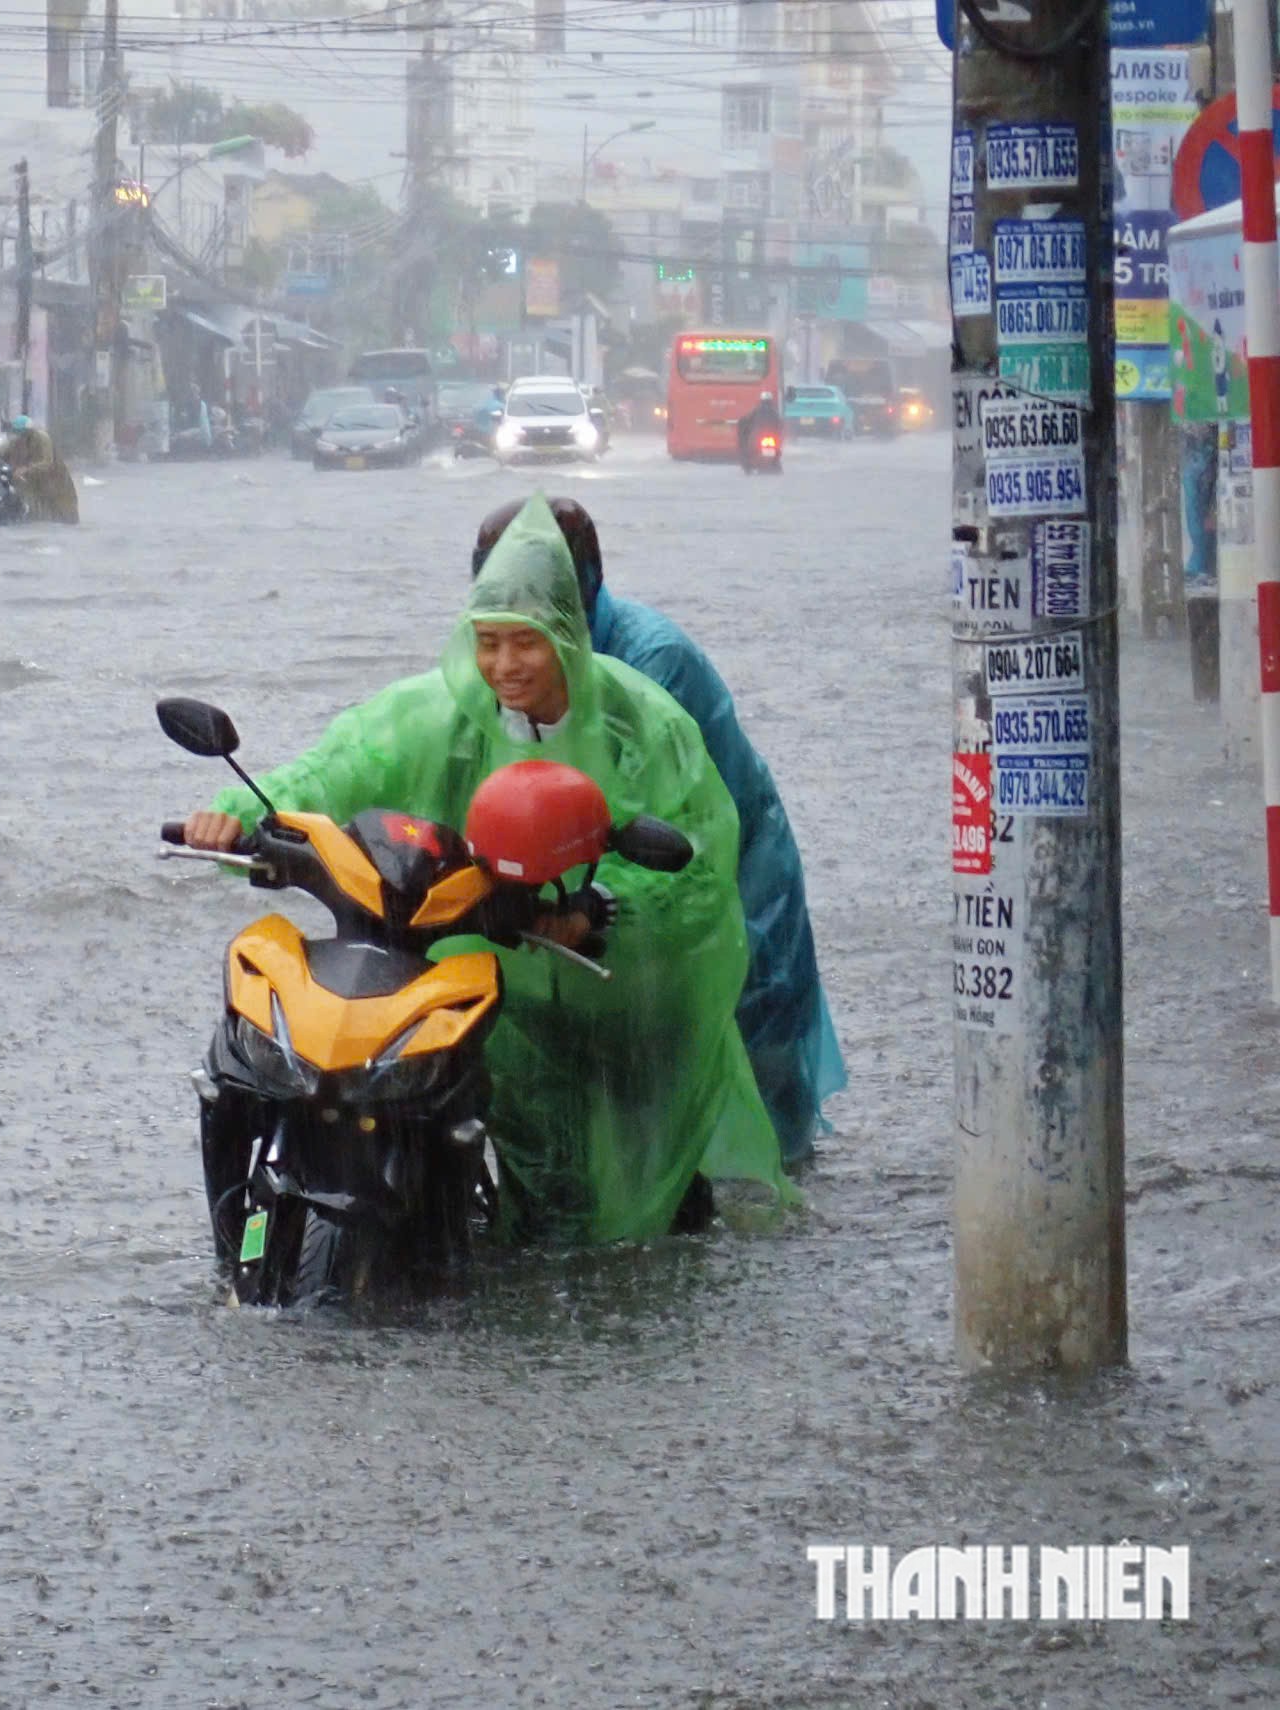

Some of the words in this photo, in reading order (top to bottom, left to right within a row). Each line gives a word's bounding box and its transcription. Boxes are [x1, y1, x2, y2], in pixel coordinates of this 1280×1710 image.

[1111, 61, 1189, 81] AMSU
[1111, 88, 1177, 104] espoke
[988, 644, 1080, 682] 0904.207.664
[995, 709, 1088, 744] 0935.570.655
